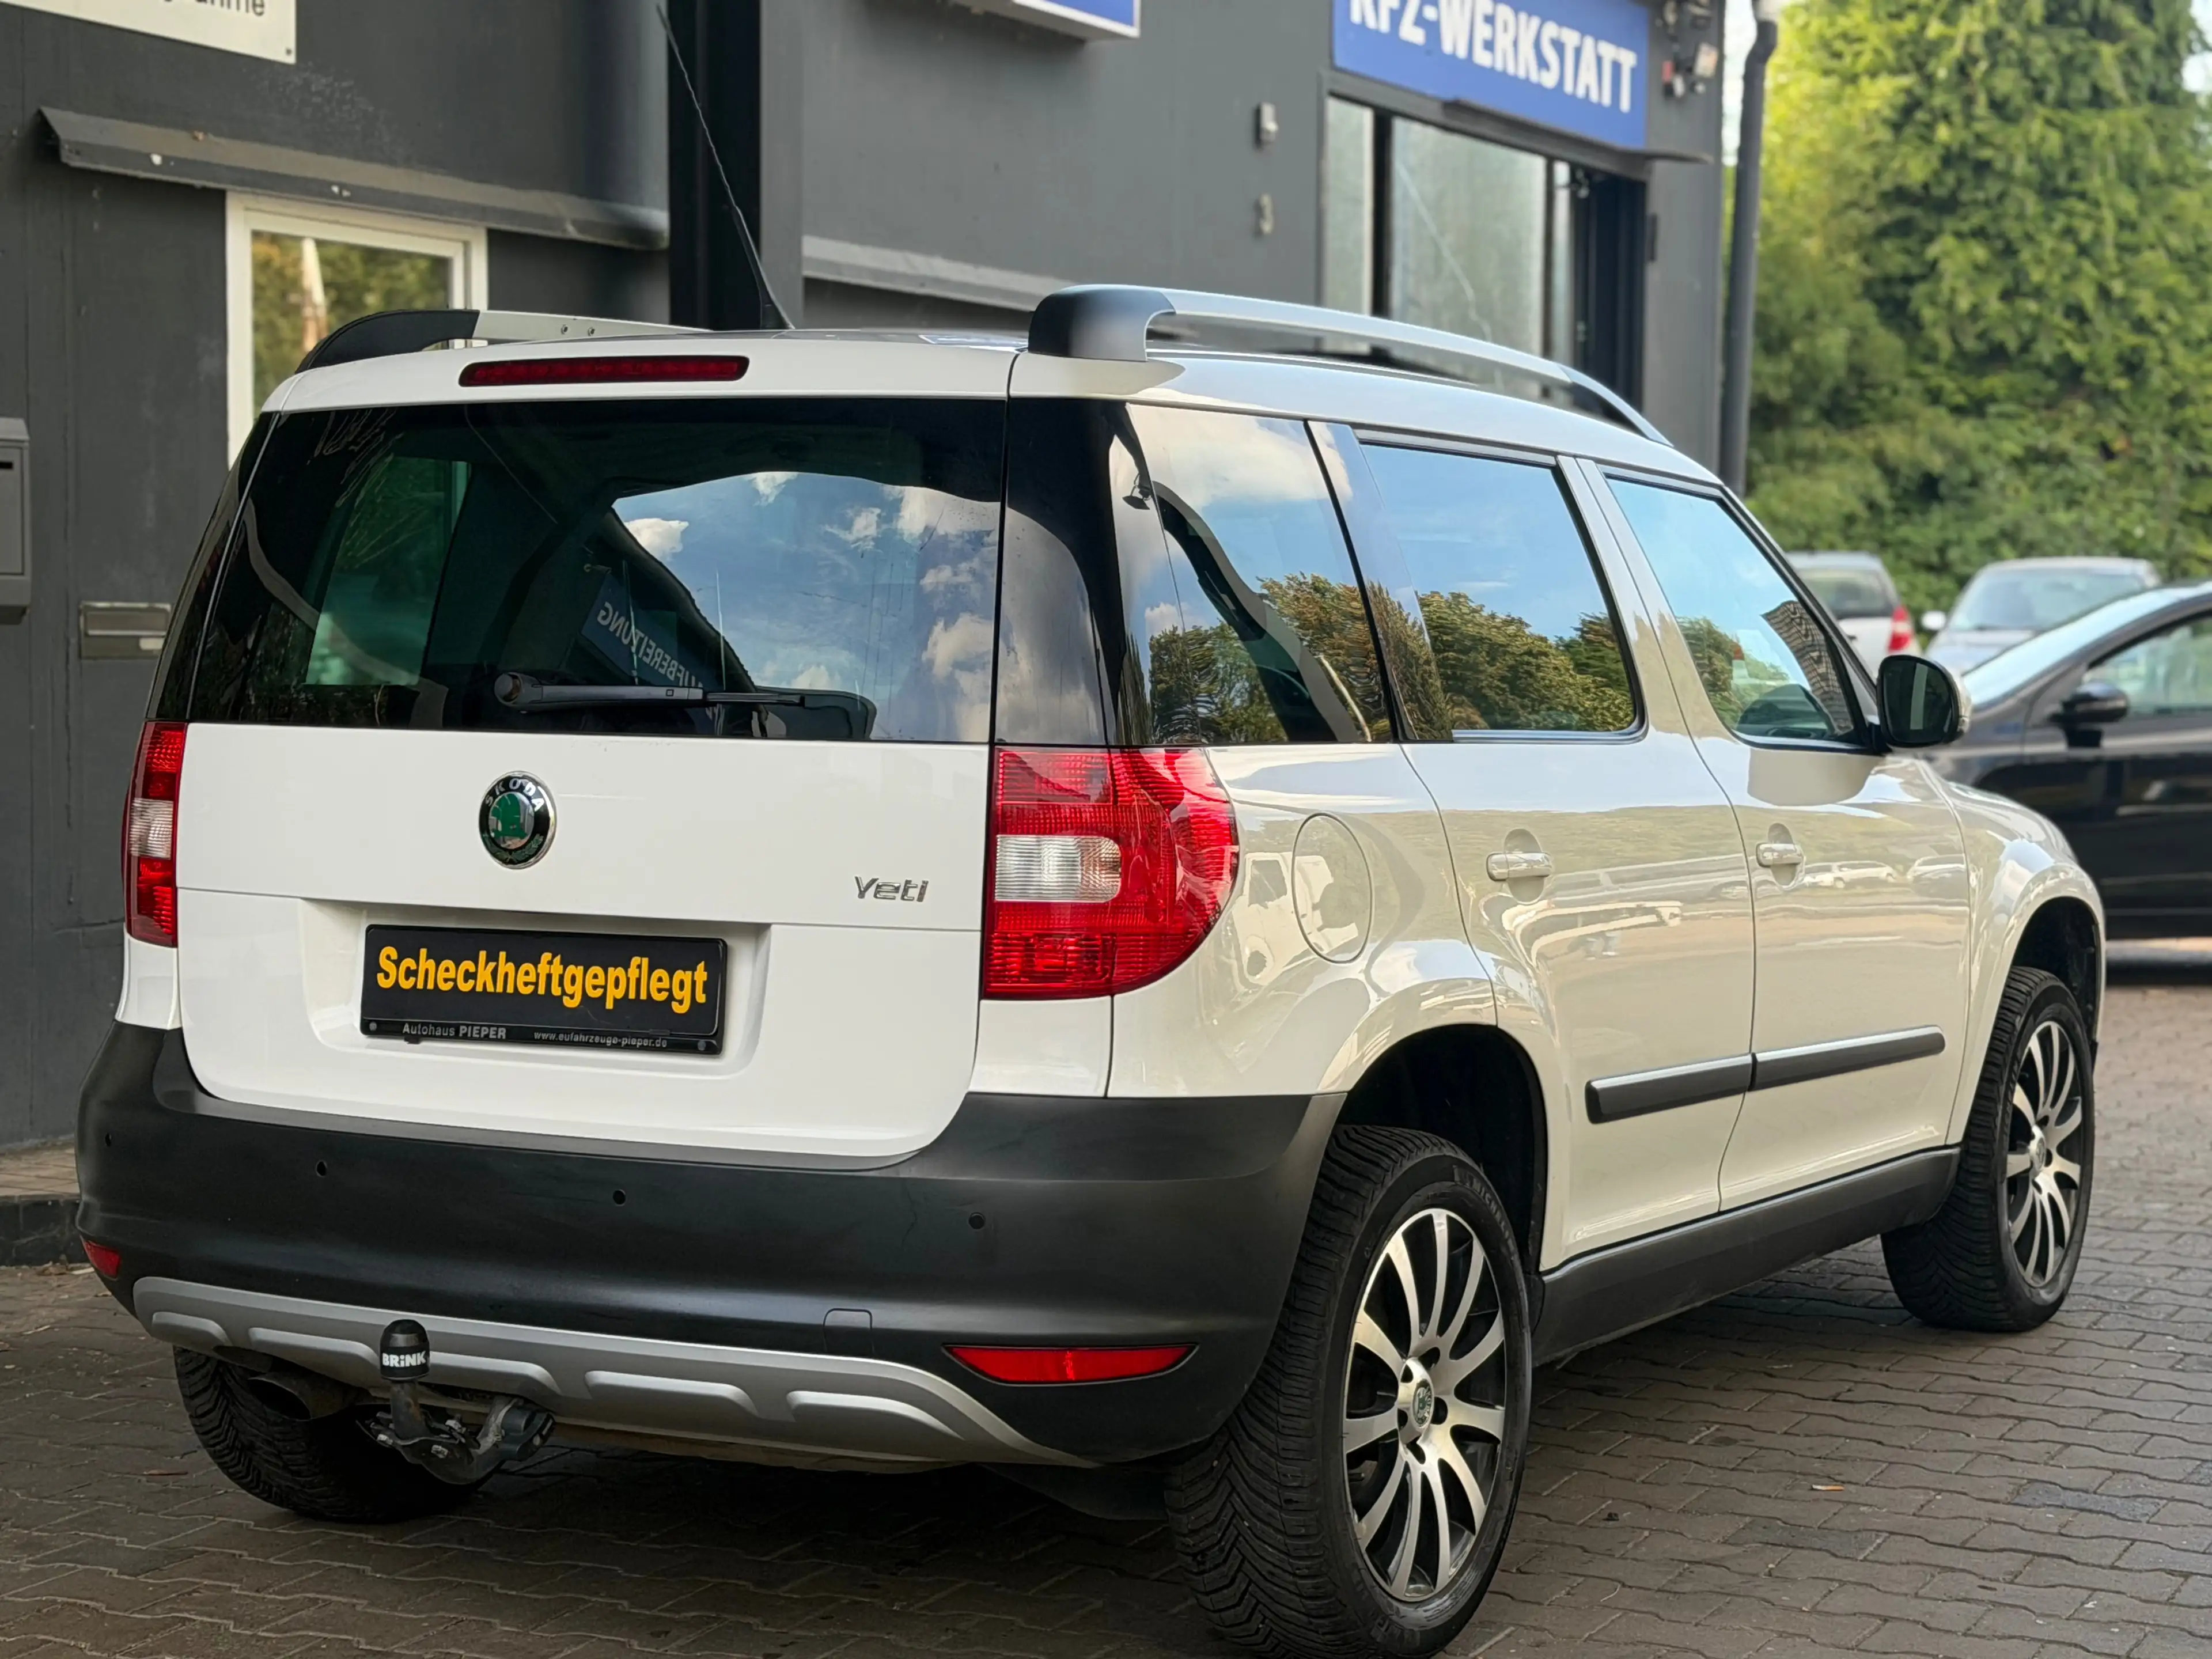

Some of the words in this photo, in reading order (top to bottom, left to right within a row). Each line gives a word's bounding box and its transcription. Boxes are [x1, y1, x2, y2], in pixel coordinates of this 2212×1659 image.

[854, 876, 929, 903] Yeti
[376, 946, 707, 1014] Scheckheftgepflegt
[402, 1022, 455, 1036] Autohaus
[459, 1025, 506, 1040] PIEPER
[533, 1031, 667, 1048] www.eufahrzeuge-pieper.de
